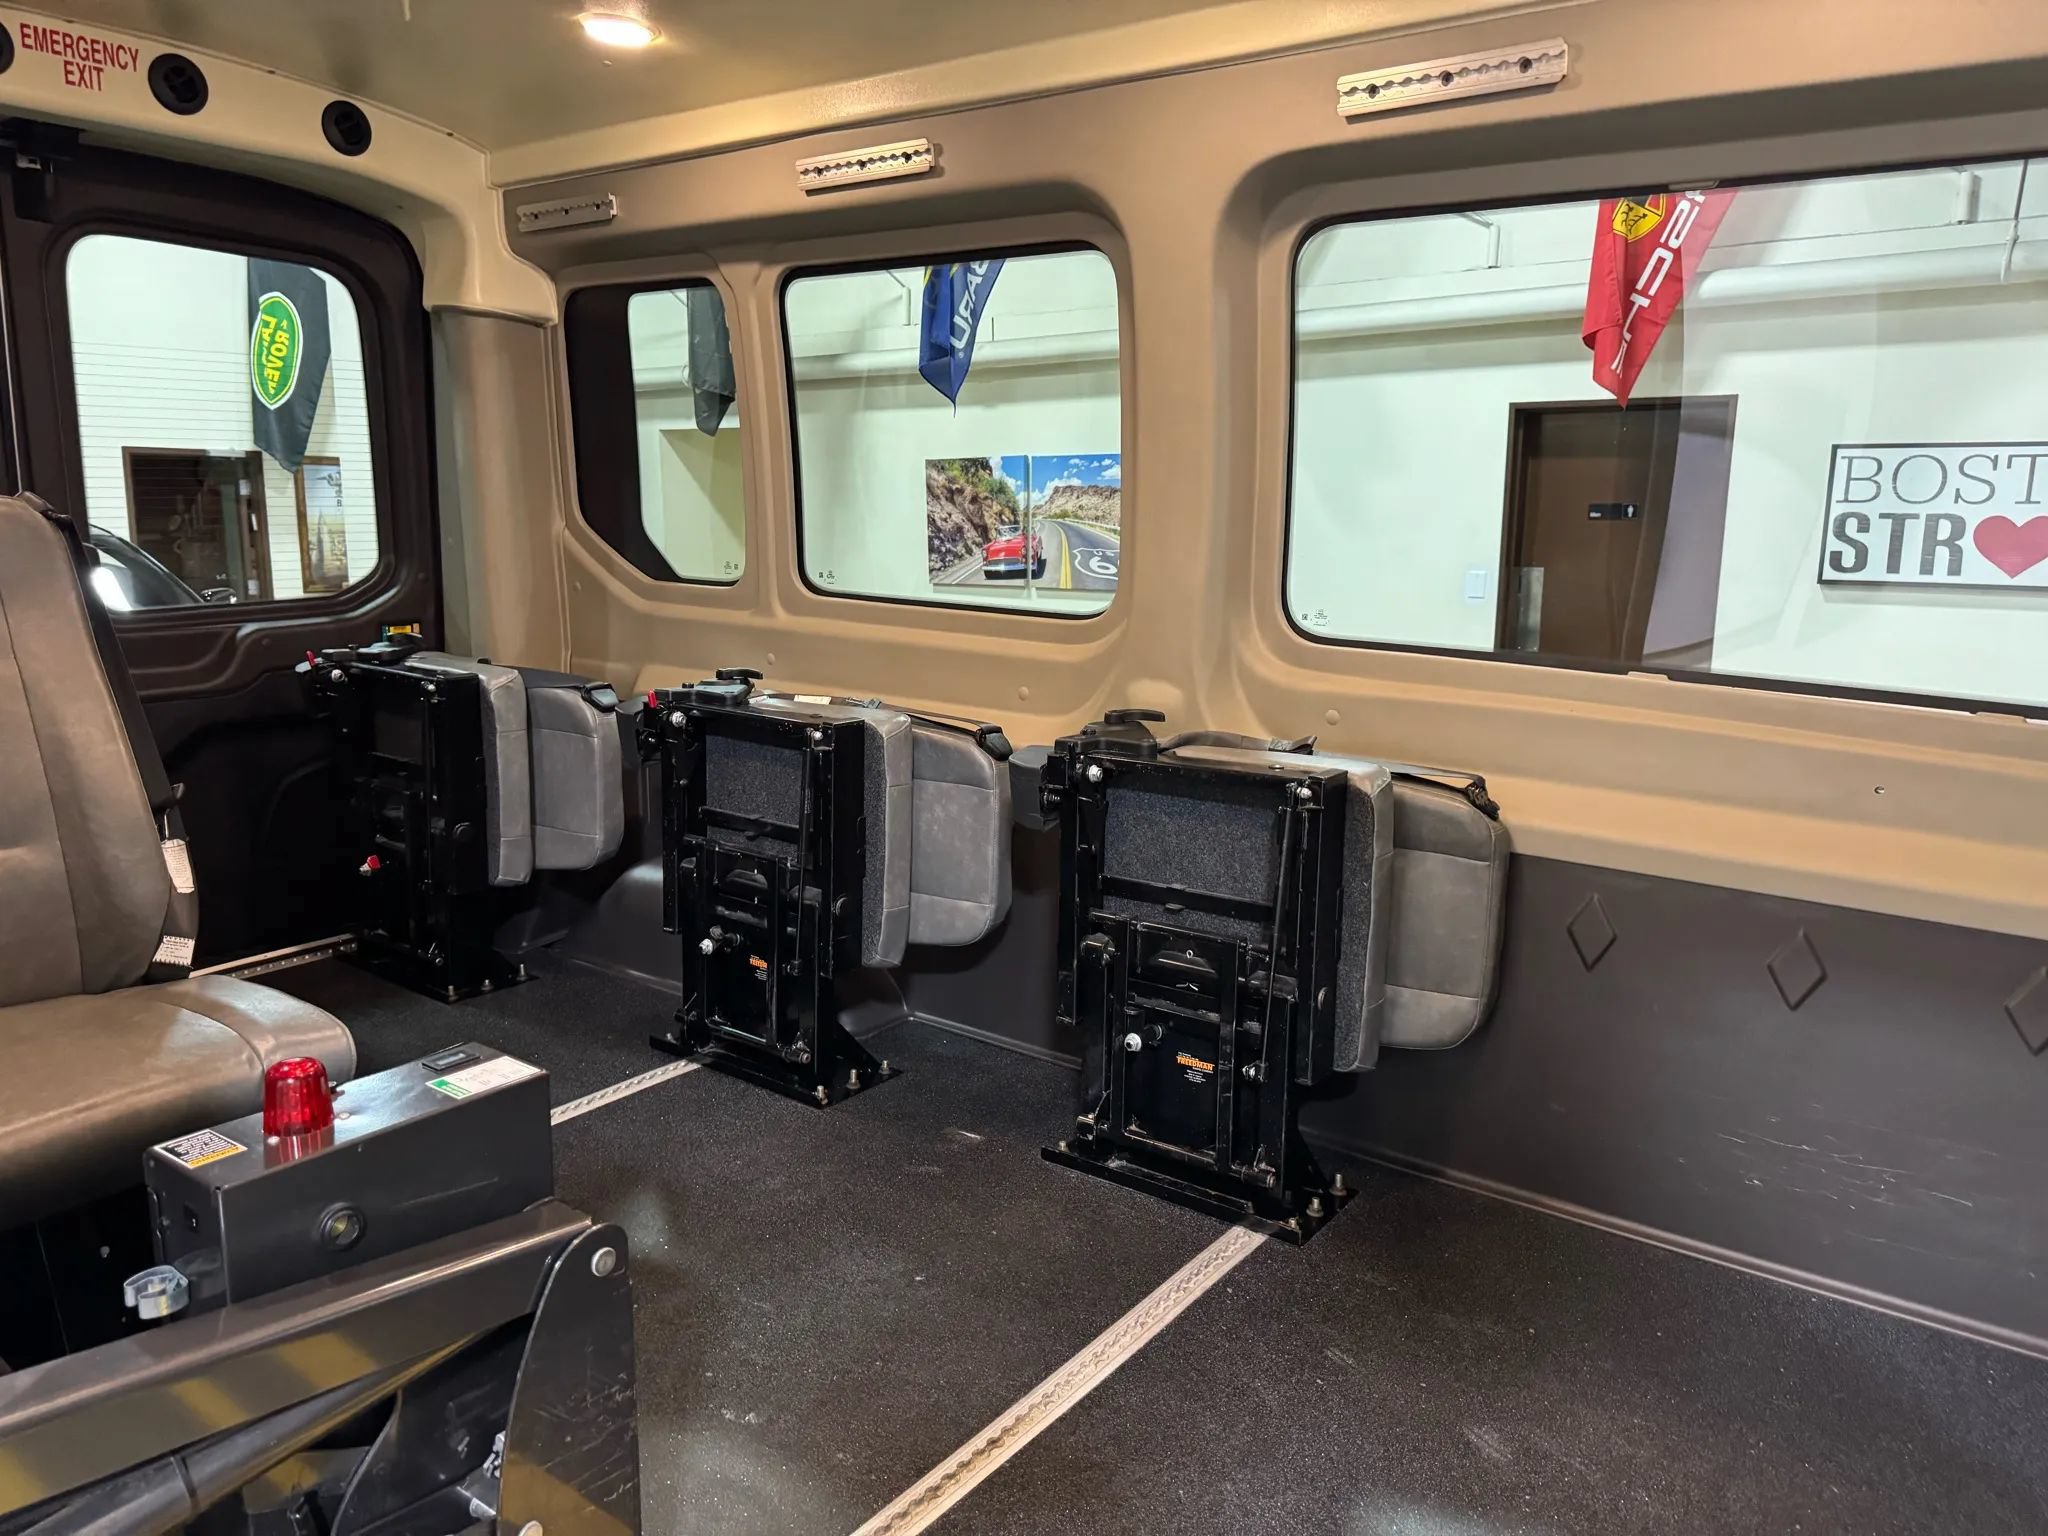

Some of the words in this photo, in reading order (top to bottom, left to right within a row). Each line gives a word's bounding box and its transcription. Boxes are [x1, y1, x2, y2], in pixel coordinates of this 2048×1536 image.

[20, 22, 139, 72] EMERGENCY
[63, 60, 104, 92] EXIT
[1836, 454, 2048, 505] BOST
